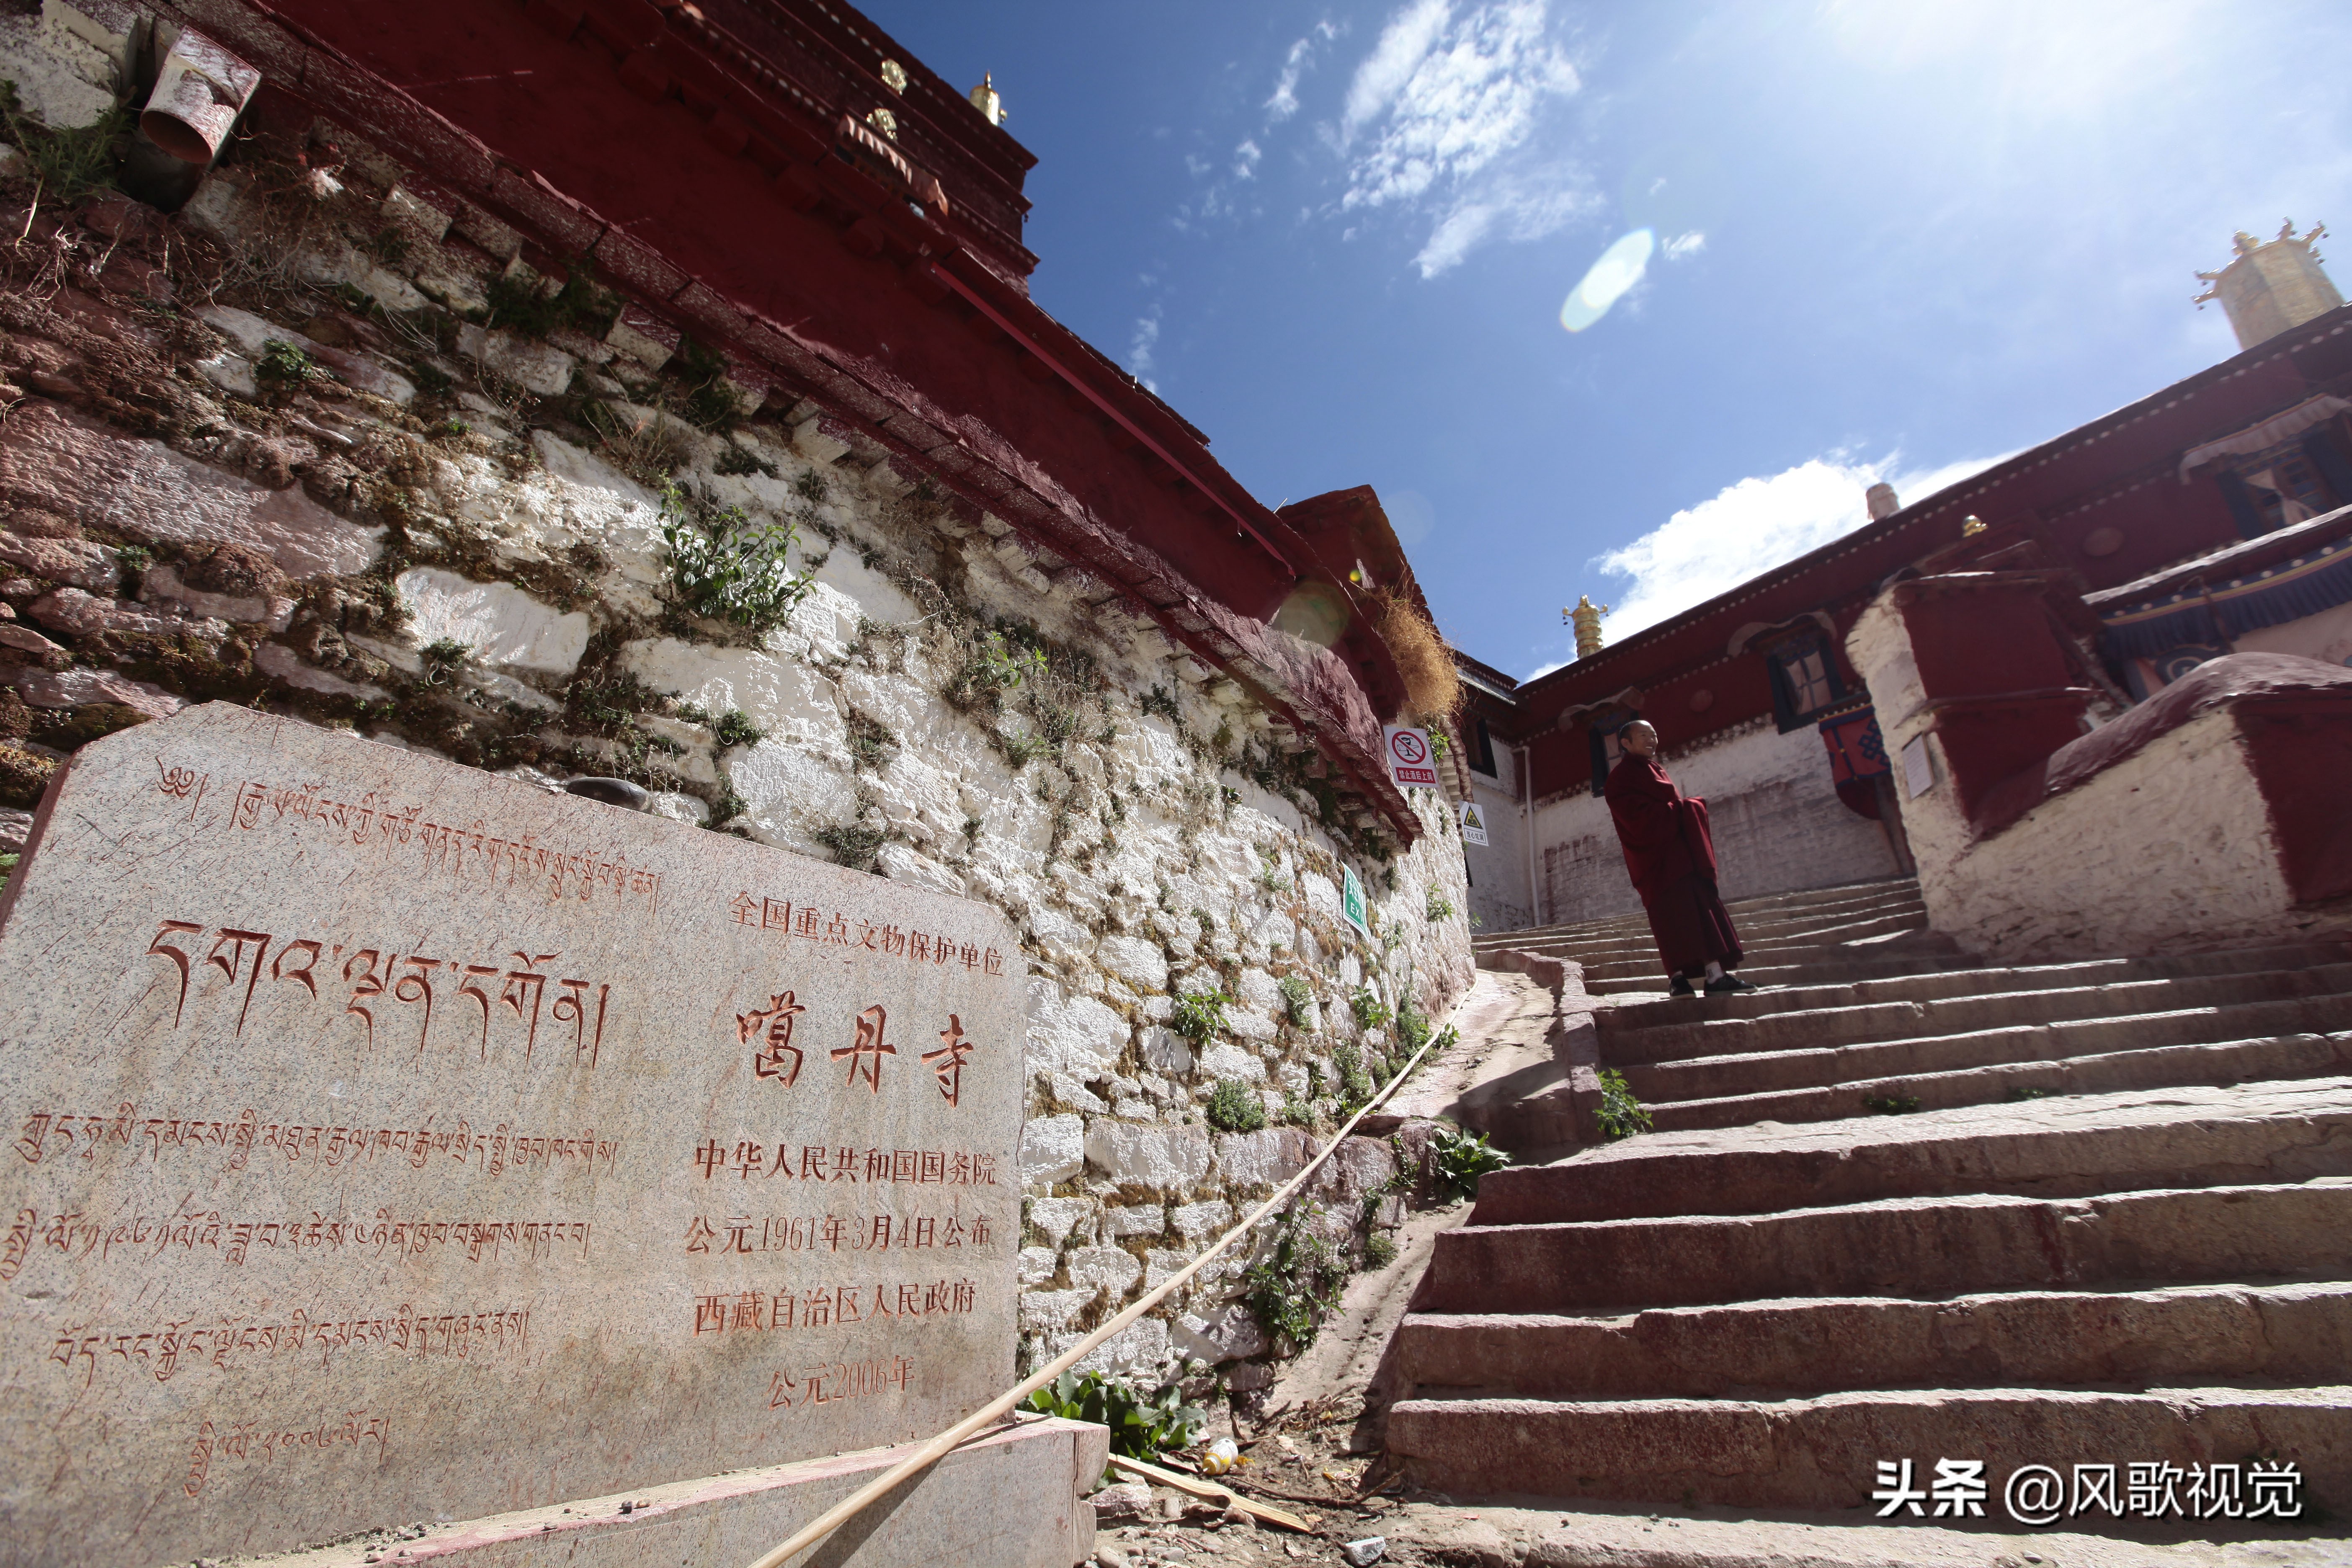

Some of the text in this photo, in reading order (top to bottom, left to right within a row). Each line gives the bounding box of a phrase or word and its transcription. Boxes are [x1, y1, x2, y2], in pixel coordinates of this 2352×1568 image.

[1399, 769, 1433, 781] 禁止酒后上岗
[727, 890, 1004, 977] 全国重点文物保护单位
[736, 990, 975, 1108] 噶丹寺
[693, 1138, 997, 1186] 中华人民共和国国务院
[683, 1214, 992, 1256] 公元1961年3月4日公布
[692, 1277, 976, 1337] 西藏自治区人民政府
[766, 1355, 916, 1411] 公元2006年
